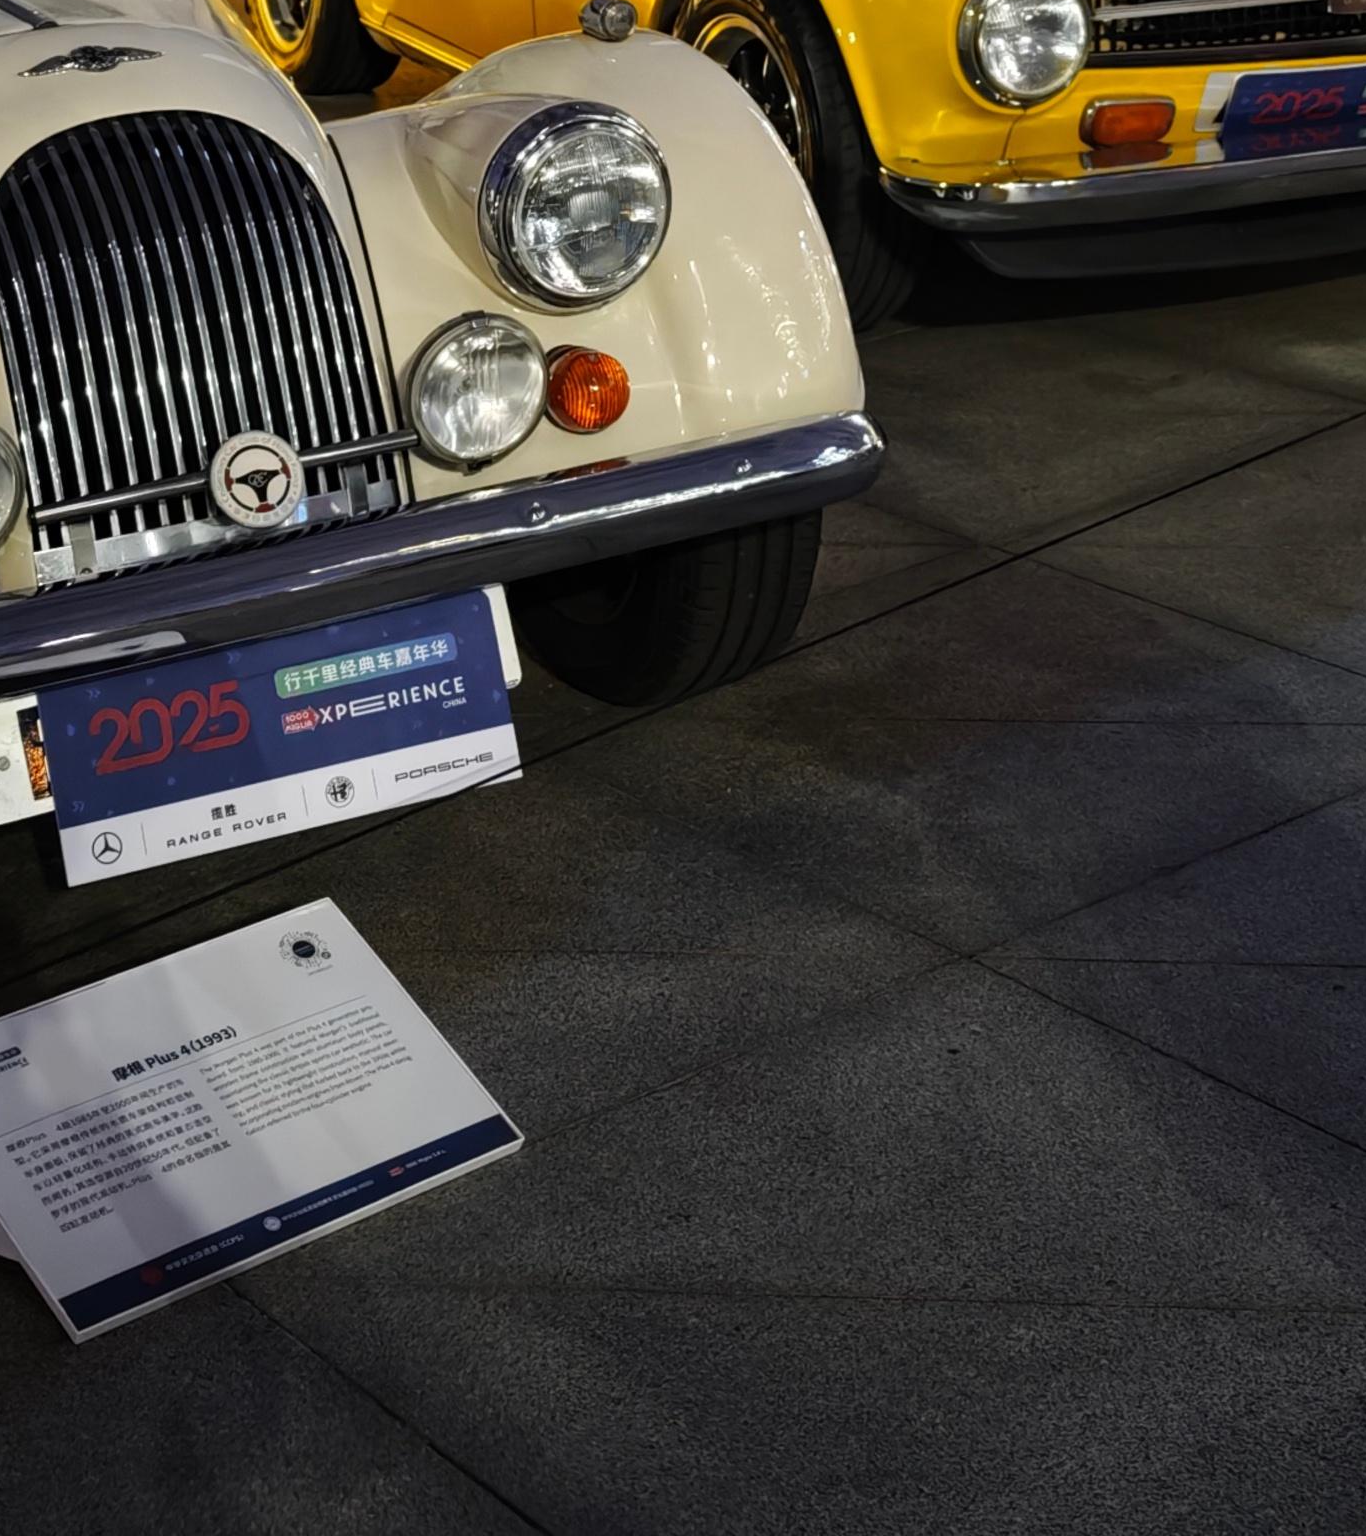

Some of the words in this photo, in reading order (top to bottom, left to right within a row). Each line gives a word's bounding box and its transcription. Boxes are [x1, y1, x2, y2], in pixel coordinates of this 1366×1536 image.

[1250, 85, 1346, 125] 2025
[284, 638, 449, 693] 行千里经典车嘉年华
[319, 675, 467, 726] XPERIENCE
[89, 679, 252, 776] 2025
[394, 751, 495, 783] PORSCHE
[166, 827, 223, 849] RANGE
[232, 812, 288, 833] ROVER
[144, 1050, 180, 1069] Plus
